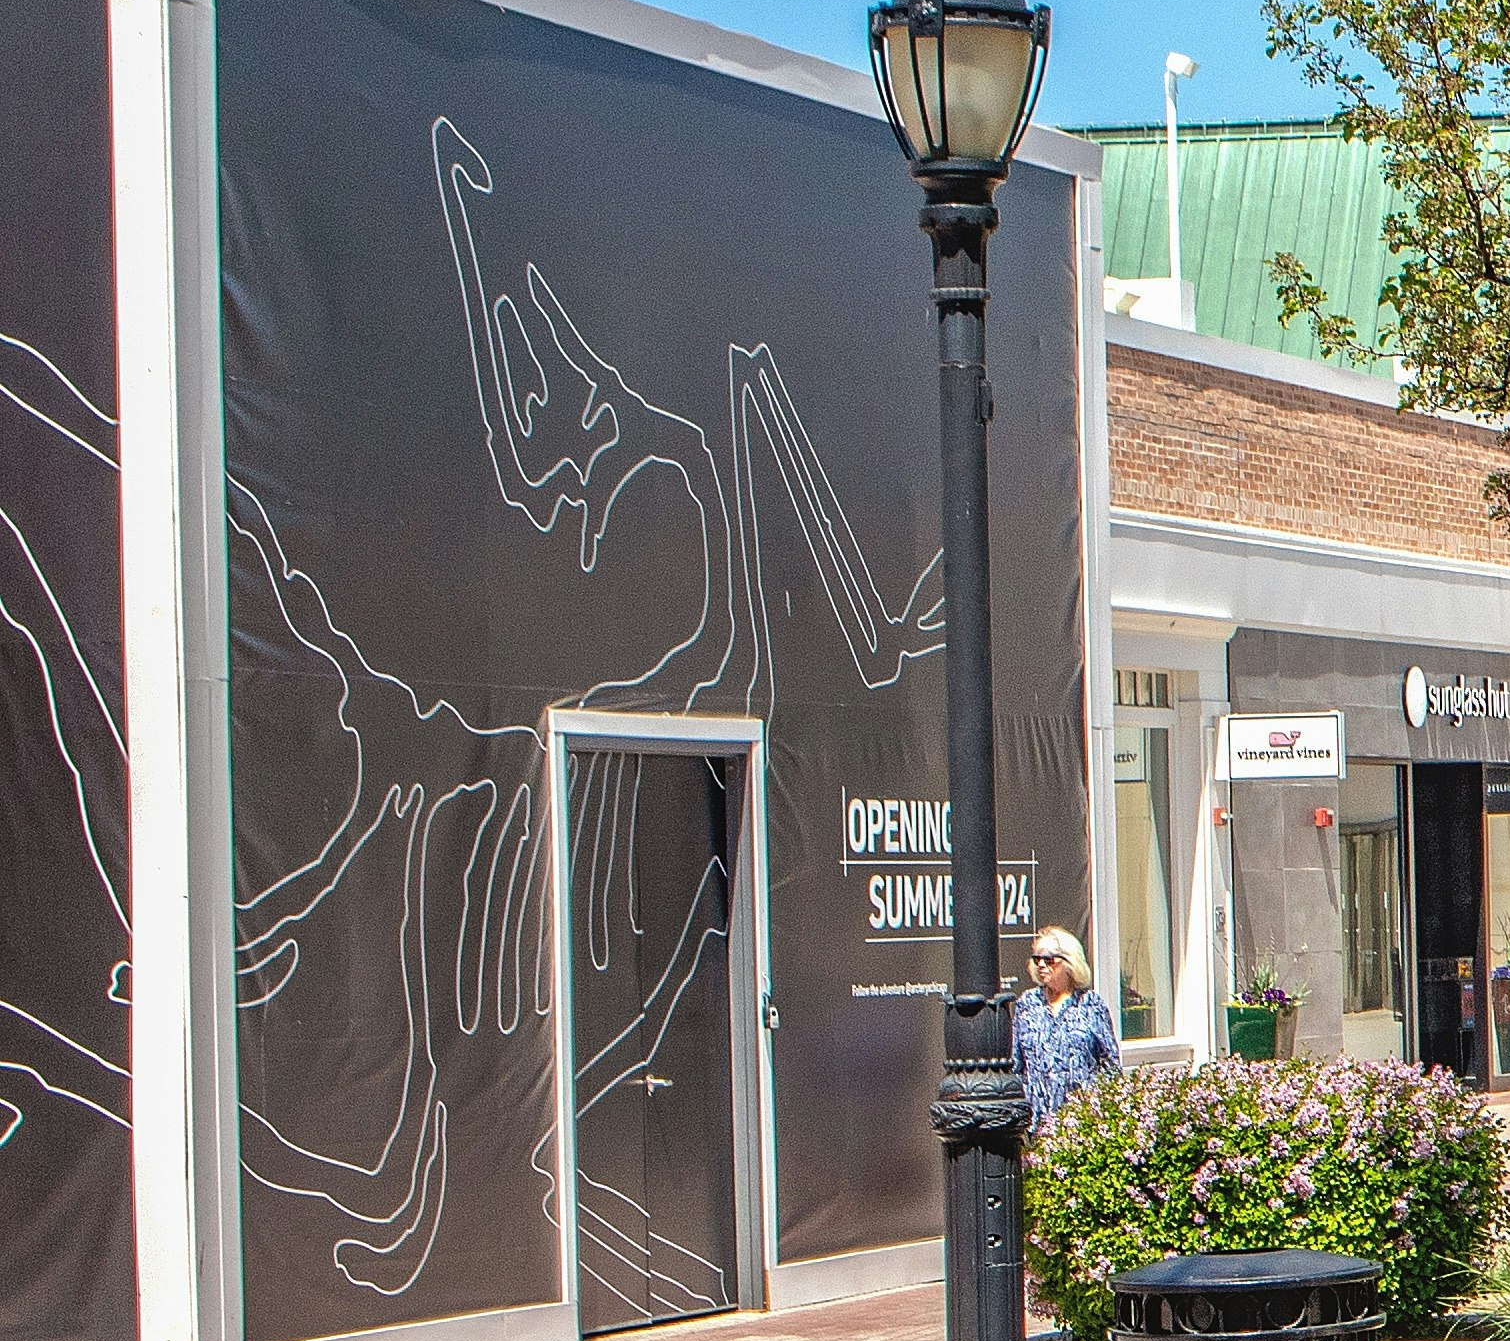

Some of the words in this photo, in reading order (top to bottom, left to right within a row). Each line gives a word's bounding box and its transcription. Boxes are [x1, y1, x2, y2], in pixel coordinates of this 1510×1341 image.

[1428, 674, 1486, 728] sunglass
[1487, 676, 1510, 719] hut
[1237, 746, 1294, 763] vineyard
[1298, 746, 1331, 760] vines
[868, 874, 954, 930] SUMME
[997, 874, 1031, 925] 24
